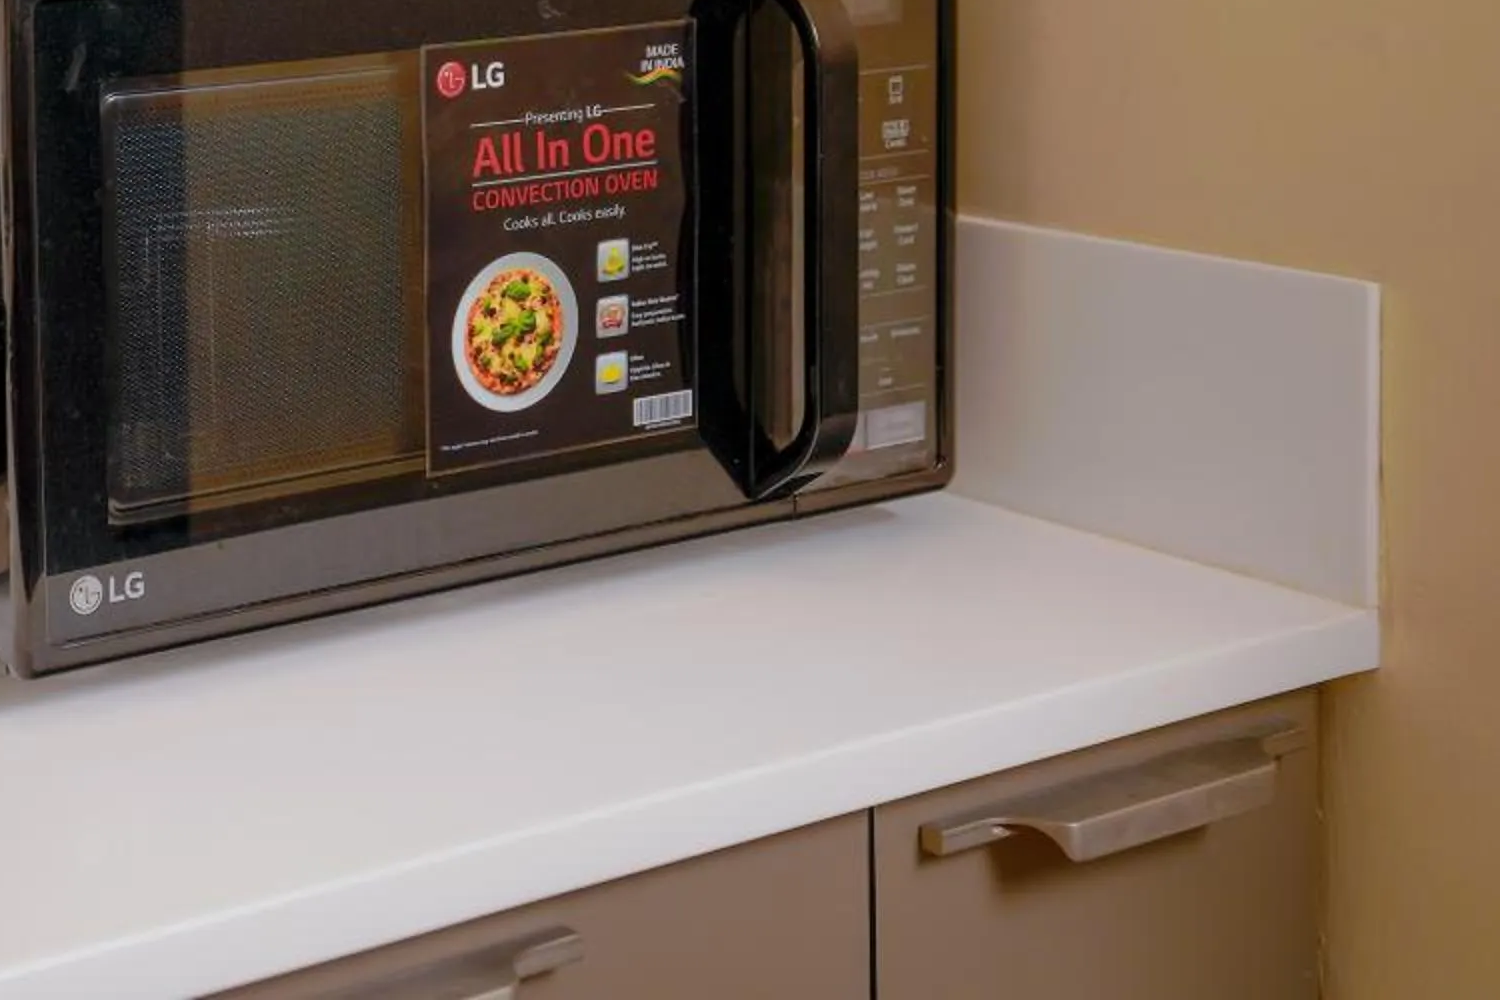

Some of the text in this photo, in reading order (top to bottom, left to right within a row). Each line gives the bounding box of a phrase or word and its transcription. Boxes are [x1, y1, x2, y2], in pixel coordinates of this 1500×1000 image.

[646, 43, 679, 58] MADE
[471, 61, 505, 90] LG
[525, 104, 602, 126] Presenting LG
[472, 123, 656, 178] All In One
[472, 169, 658, 211] CONVECTION OVEN
[503, 215, 539, 231] Cooks
[559, 209, 593, 223] Cooks
[109, 571, 145, 603] LG
